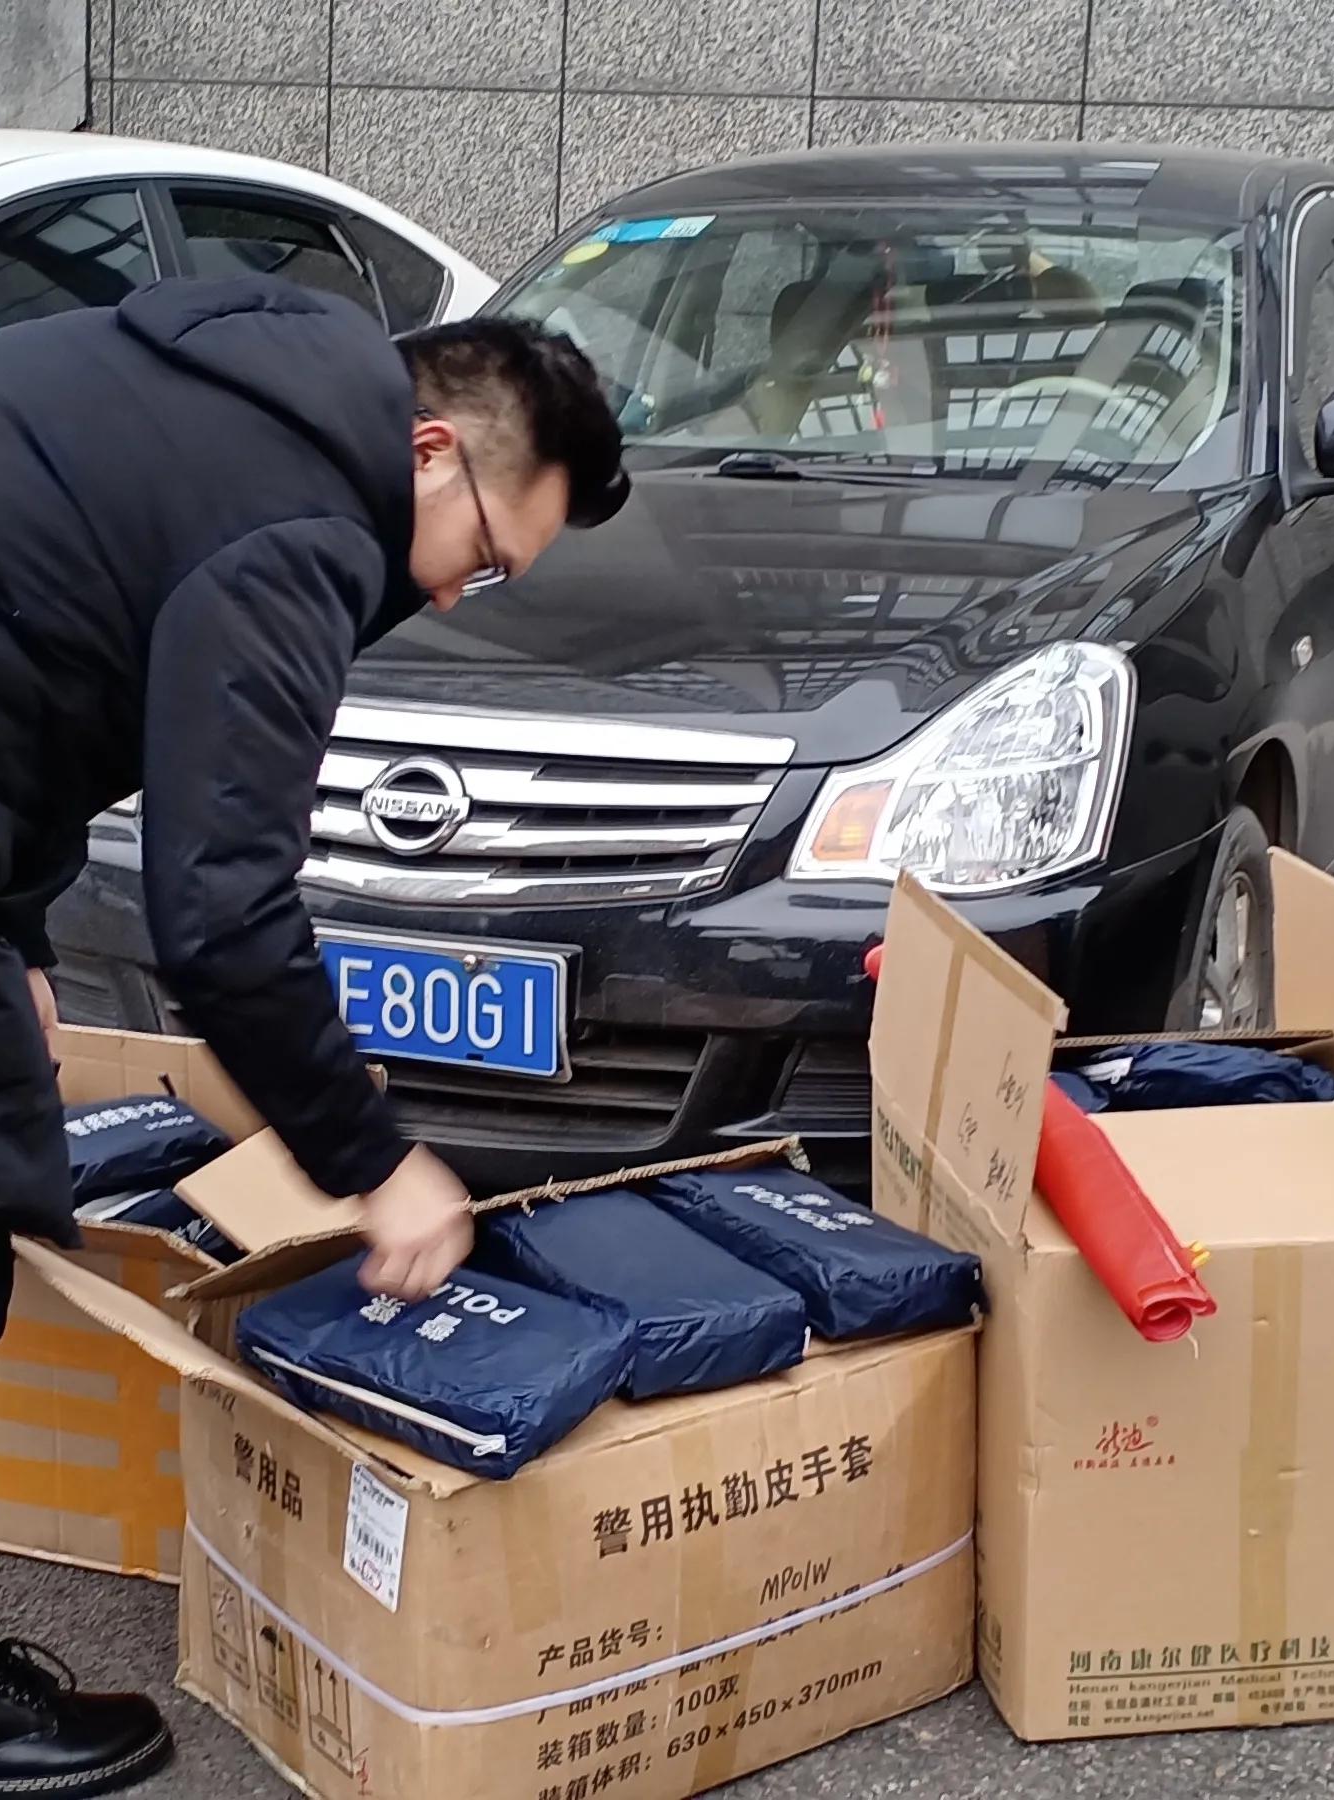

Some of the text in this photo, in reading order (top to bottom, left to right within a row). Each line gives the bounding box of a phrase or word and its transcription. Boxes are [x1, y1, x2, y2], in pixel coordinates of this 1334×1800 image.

[369, 795, 454, 817] NISSAN
[429, 1282, 527, 1325] POLI
[232, 1431, 303, 1522] 警用品
[592, 1434, 874, 1560] 警用执勤皮手套
[1221, 1671, 1281, 1686] Medical
